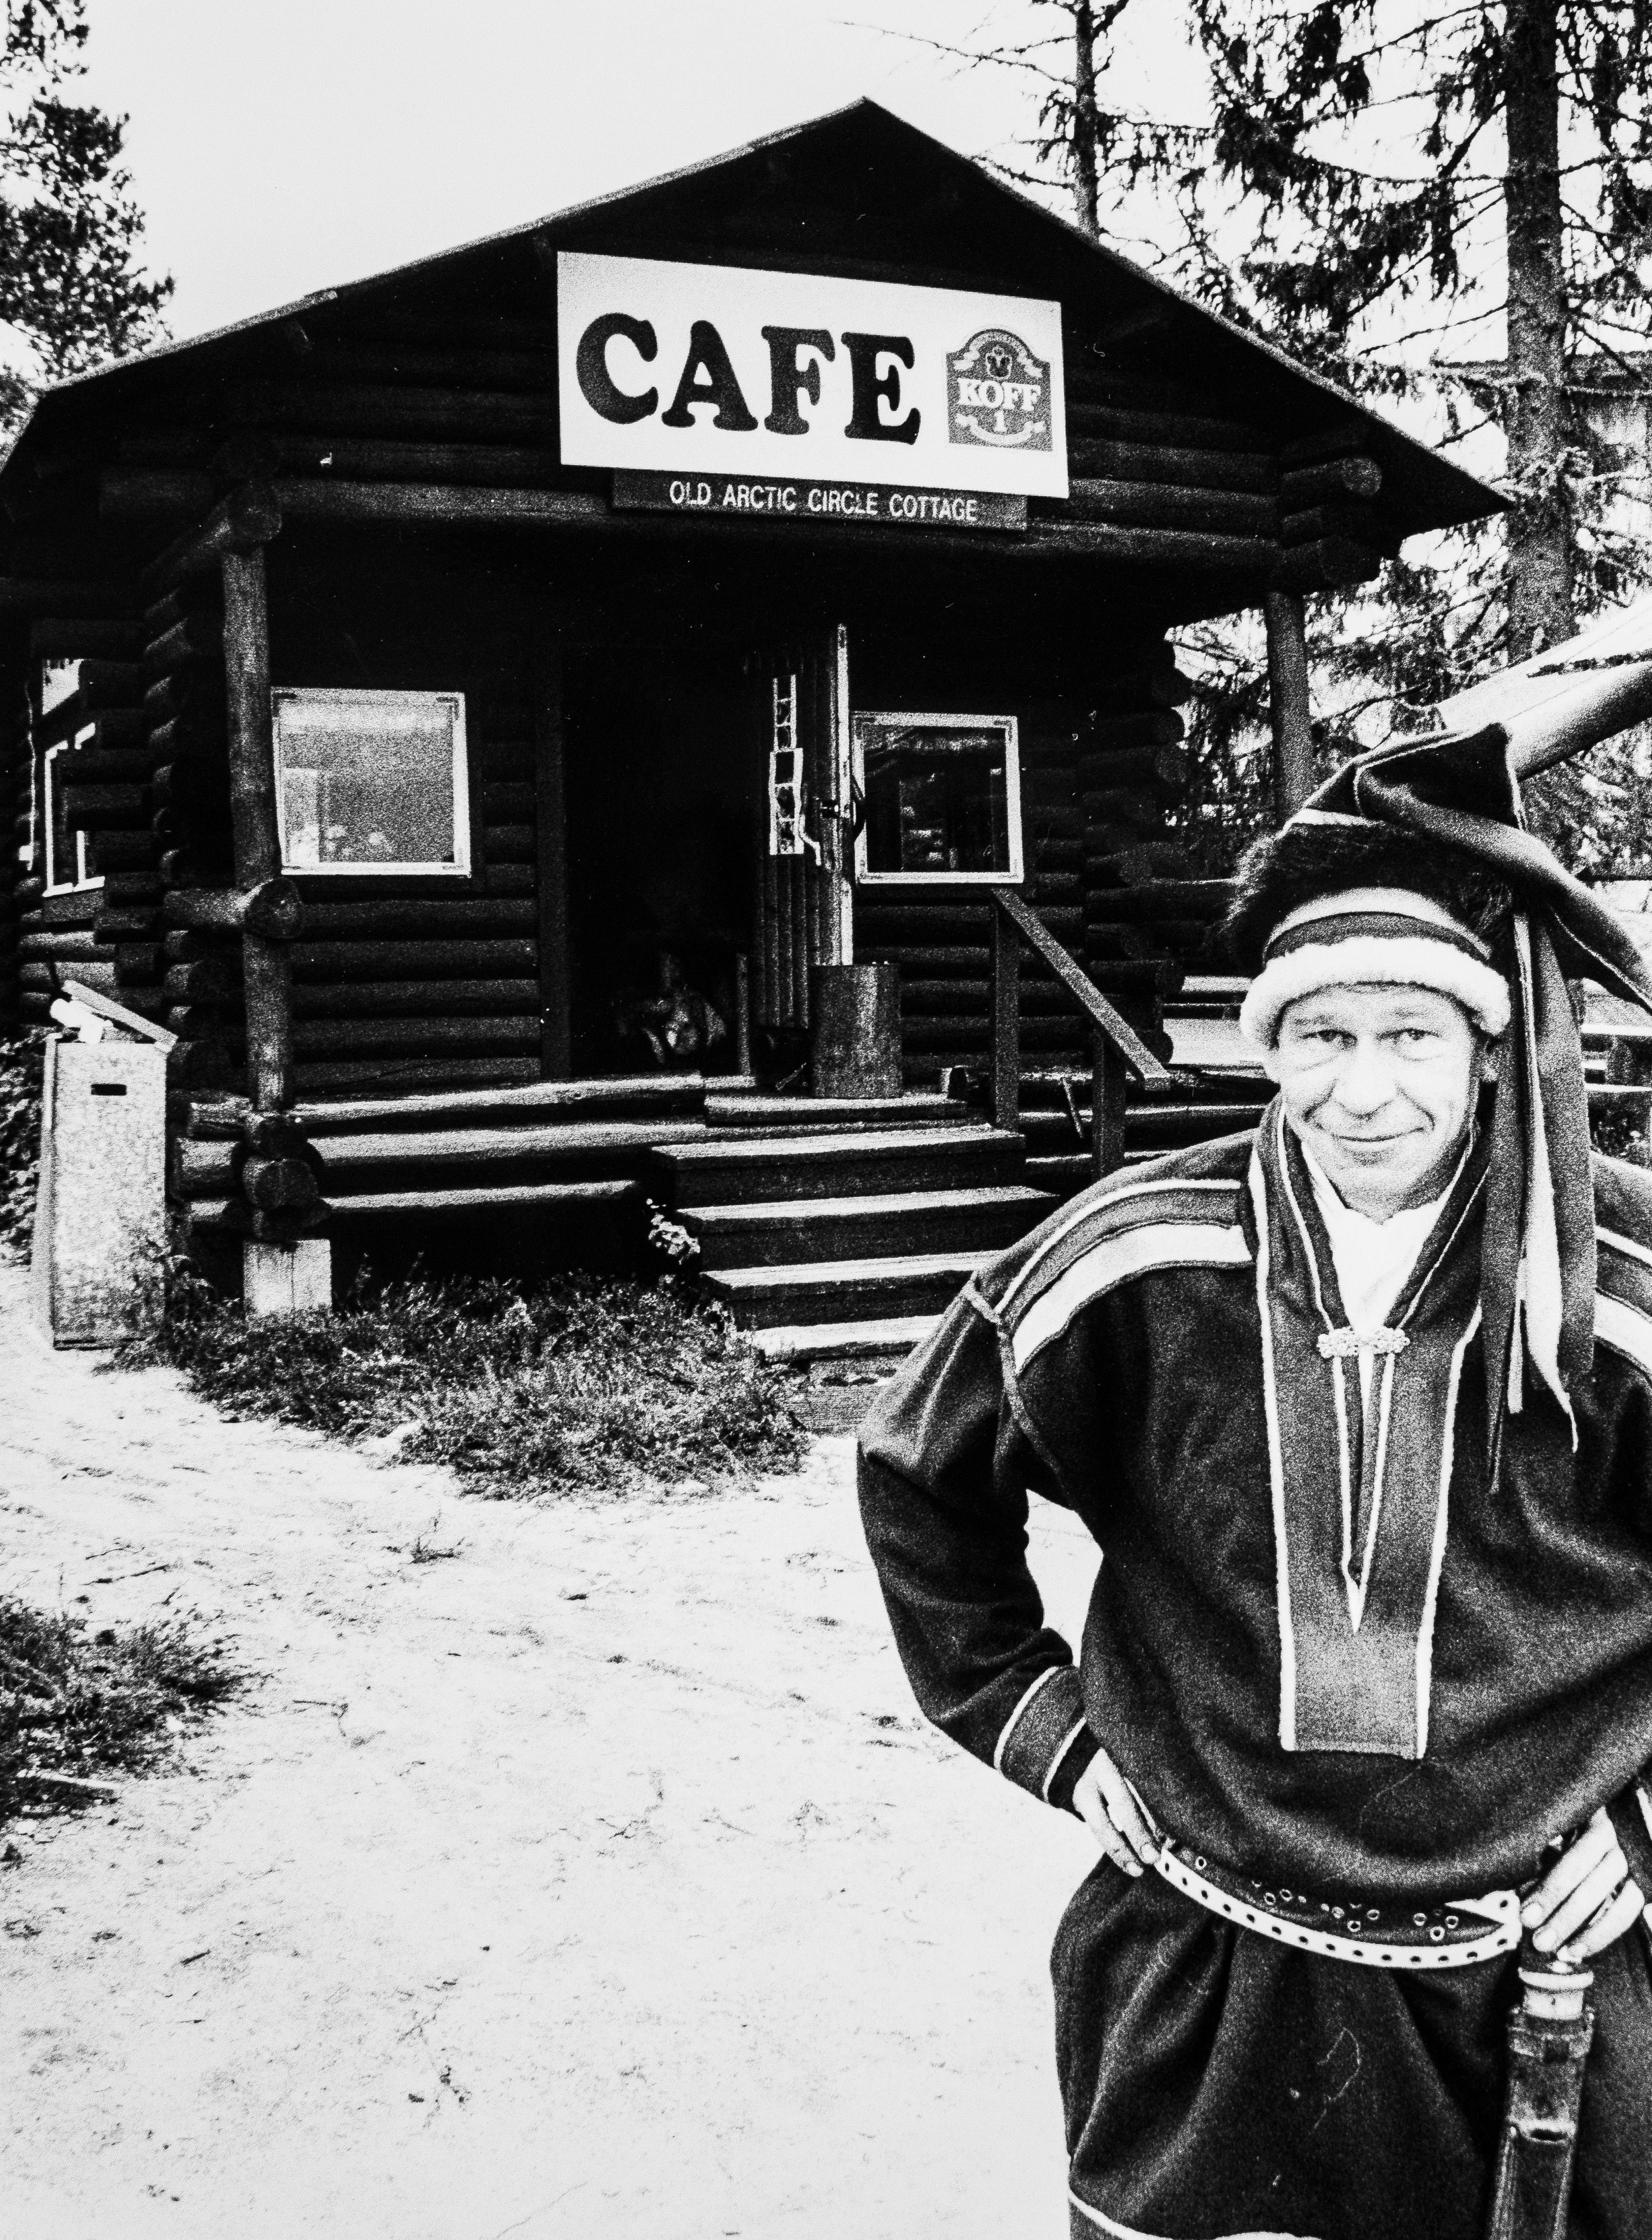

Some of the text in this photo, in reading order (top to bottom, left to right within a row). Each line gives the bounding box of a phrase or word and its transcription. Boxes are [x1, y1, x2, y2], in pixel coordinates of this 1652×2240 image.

[576, 312, 921, 445] CAFE
[957, 378, 1041, 411] KOFF
[669, 481, 978, 522] OLD ARCTIC CIRCLE COTTAGE
